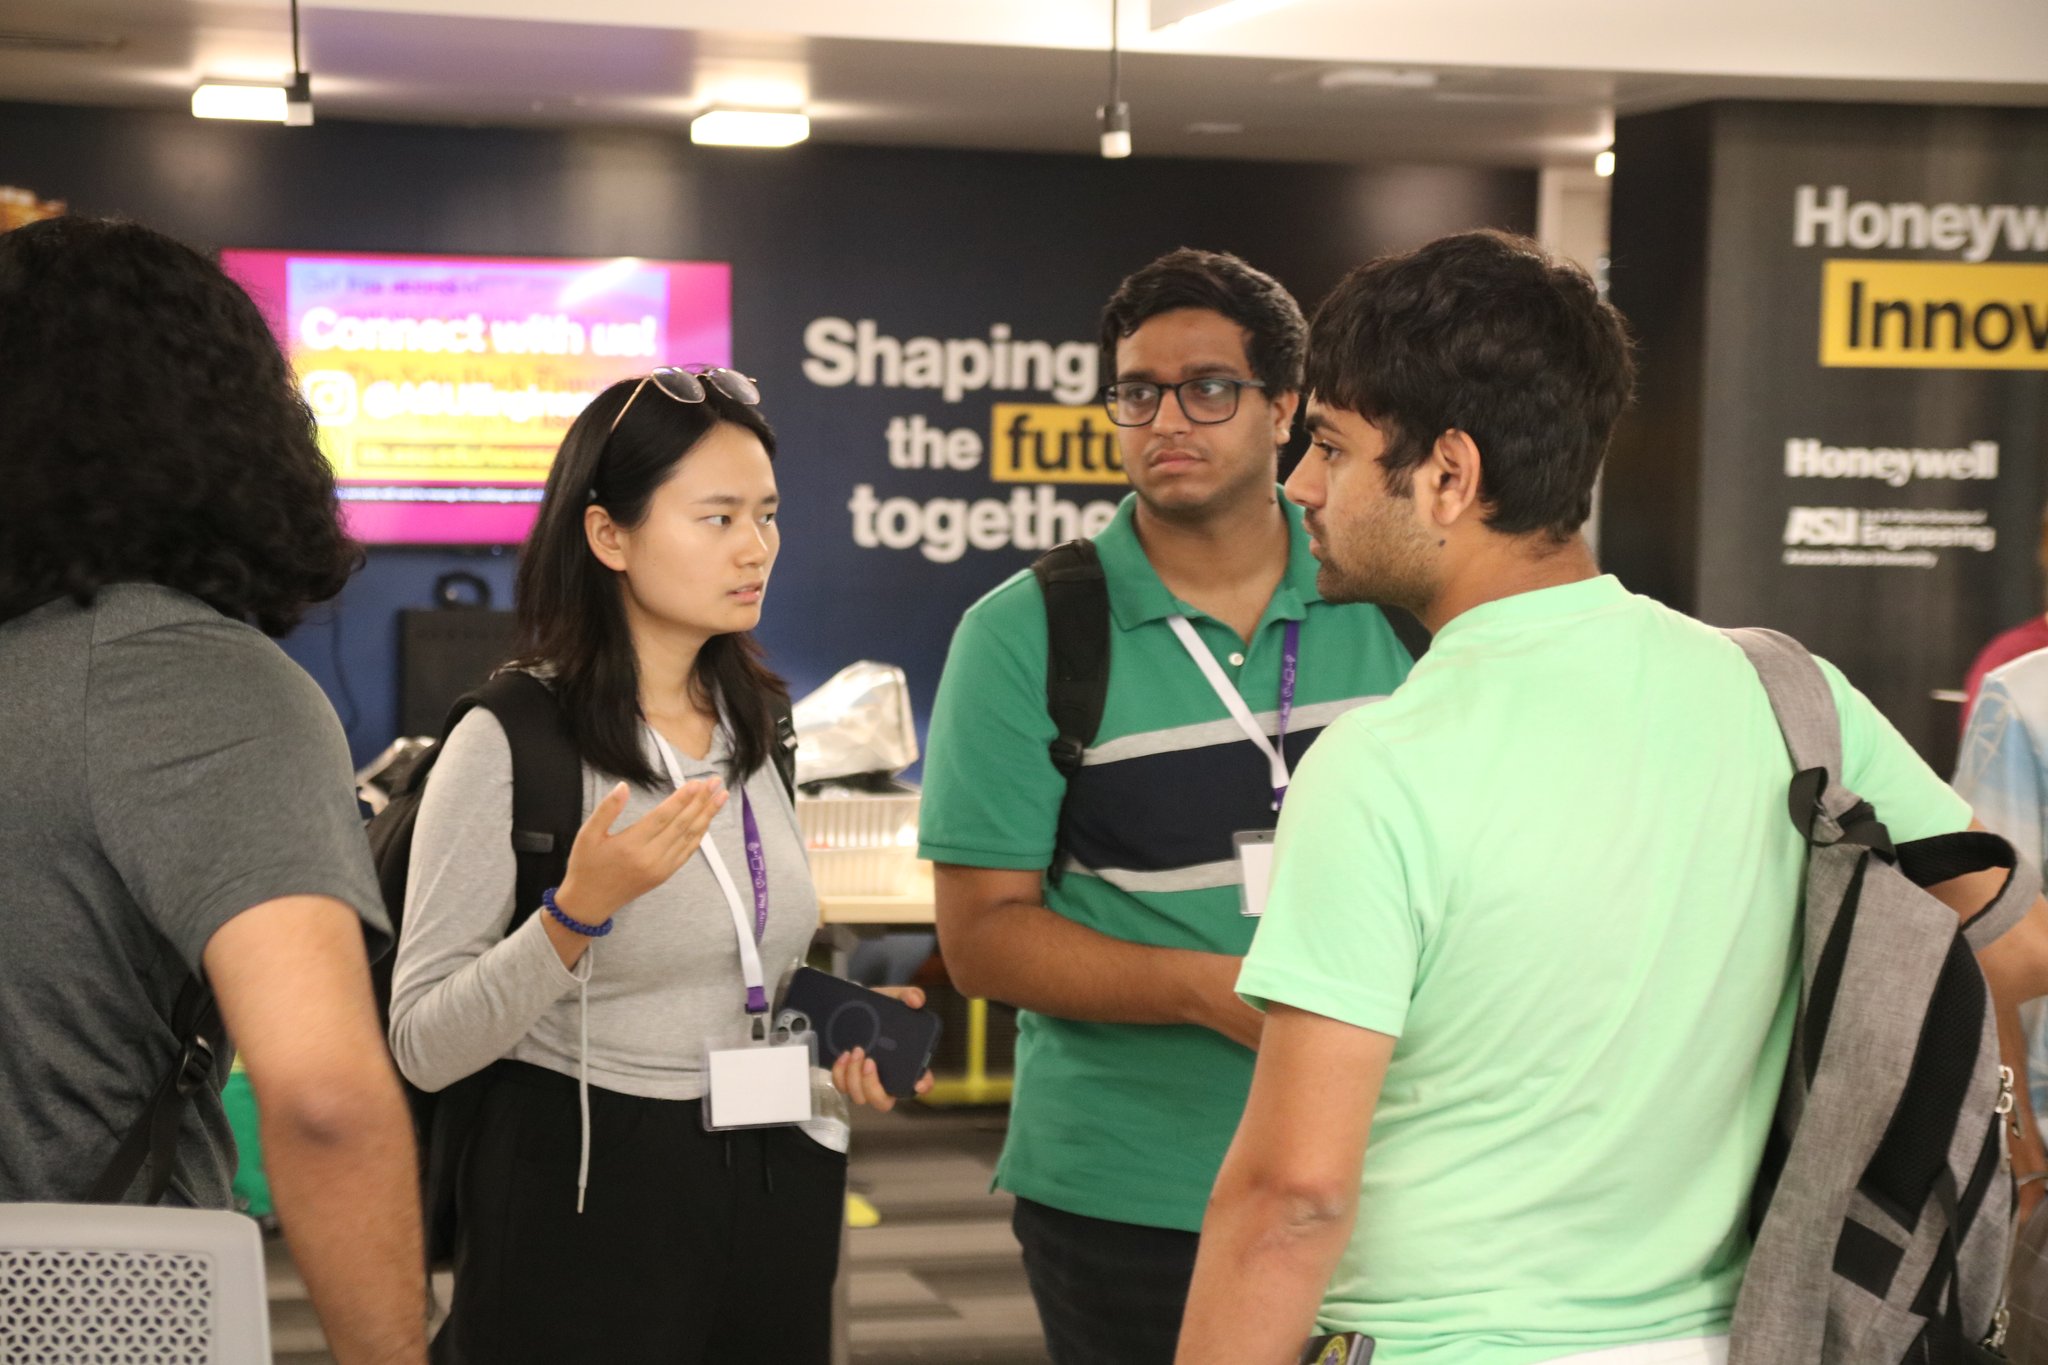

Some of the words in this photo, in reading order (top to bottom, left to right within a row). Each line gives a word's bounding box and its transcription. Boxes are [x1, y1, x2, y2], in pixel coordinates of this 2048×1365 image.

[1793, 185, 2048, 263] Honeyw
[302, 306, 487, 352] Connect
[491, 313, 585, 354] with
[590, 315, 657, 356] us!
[1849, 281, 2048, 351] Innov
[802, 317, 1099, 404] Shaping
[885, 415, 982, 470] the
[1784, 438, 1998, 487] Honeywell
[1783, 507, 1859, 545] ASU
